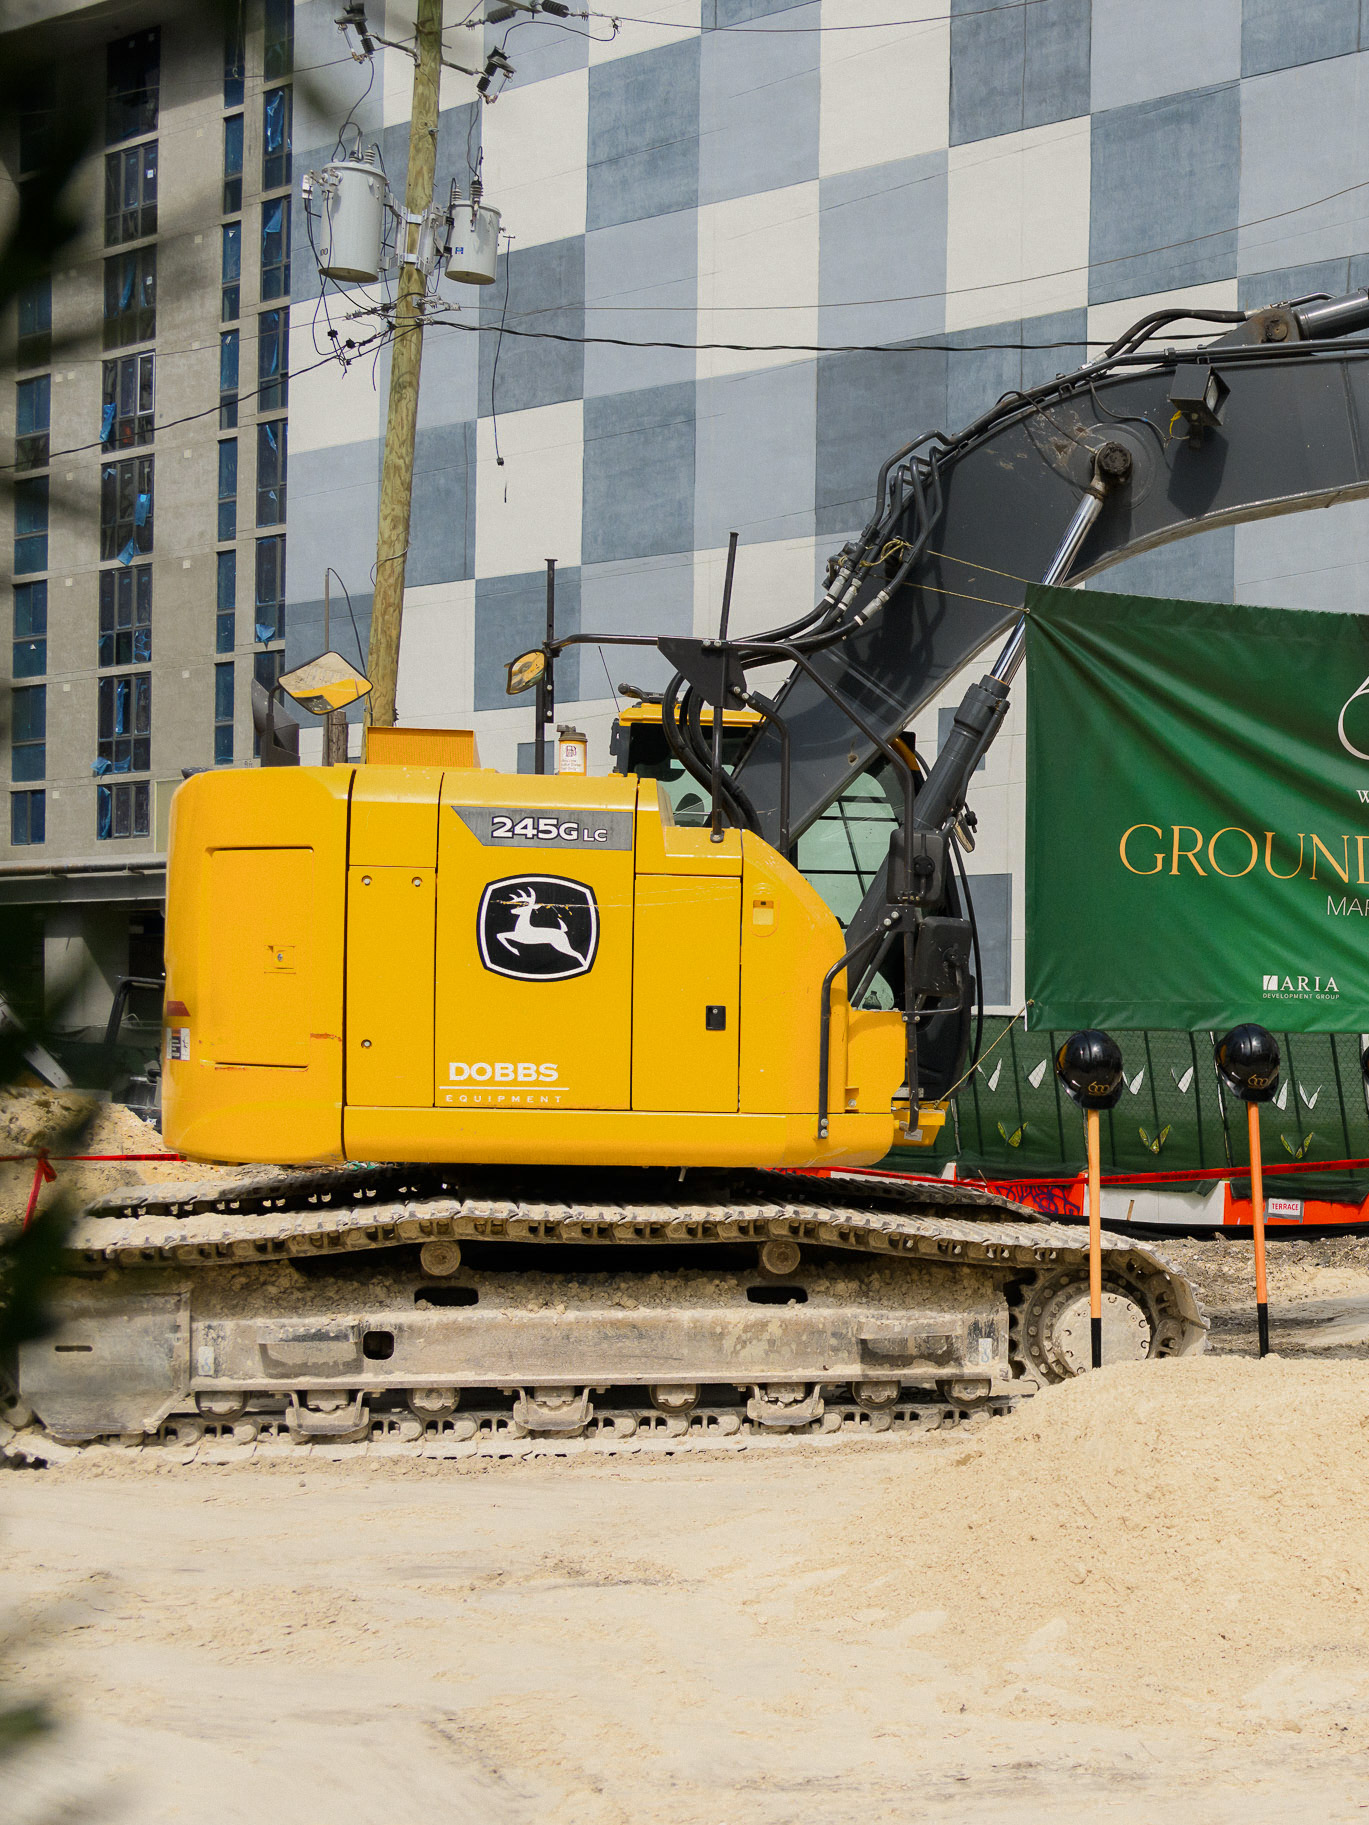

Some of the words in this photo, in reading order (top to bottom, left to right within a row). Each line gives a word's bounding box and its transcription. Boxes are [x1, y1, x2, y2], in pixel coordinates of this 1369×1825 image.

[491, 816, 579, 841] 245G
[583, 828, 608, 842] LC
[1279, 975, 1340, 992] ARIA
[448, 1061, 559, 1082] DOBBS
[445, 1094, 562, 1103] EQUIPMENT
[1271, 1202, 1299, 1211] TERRACE
